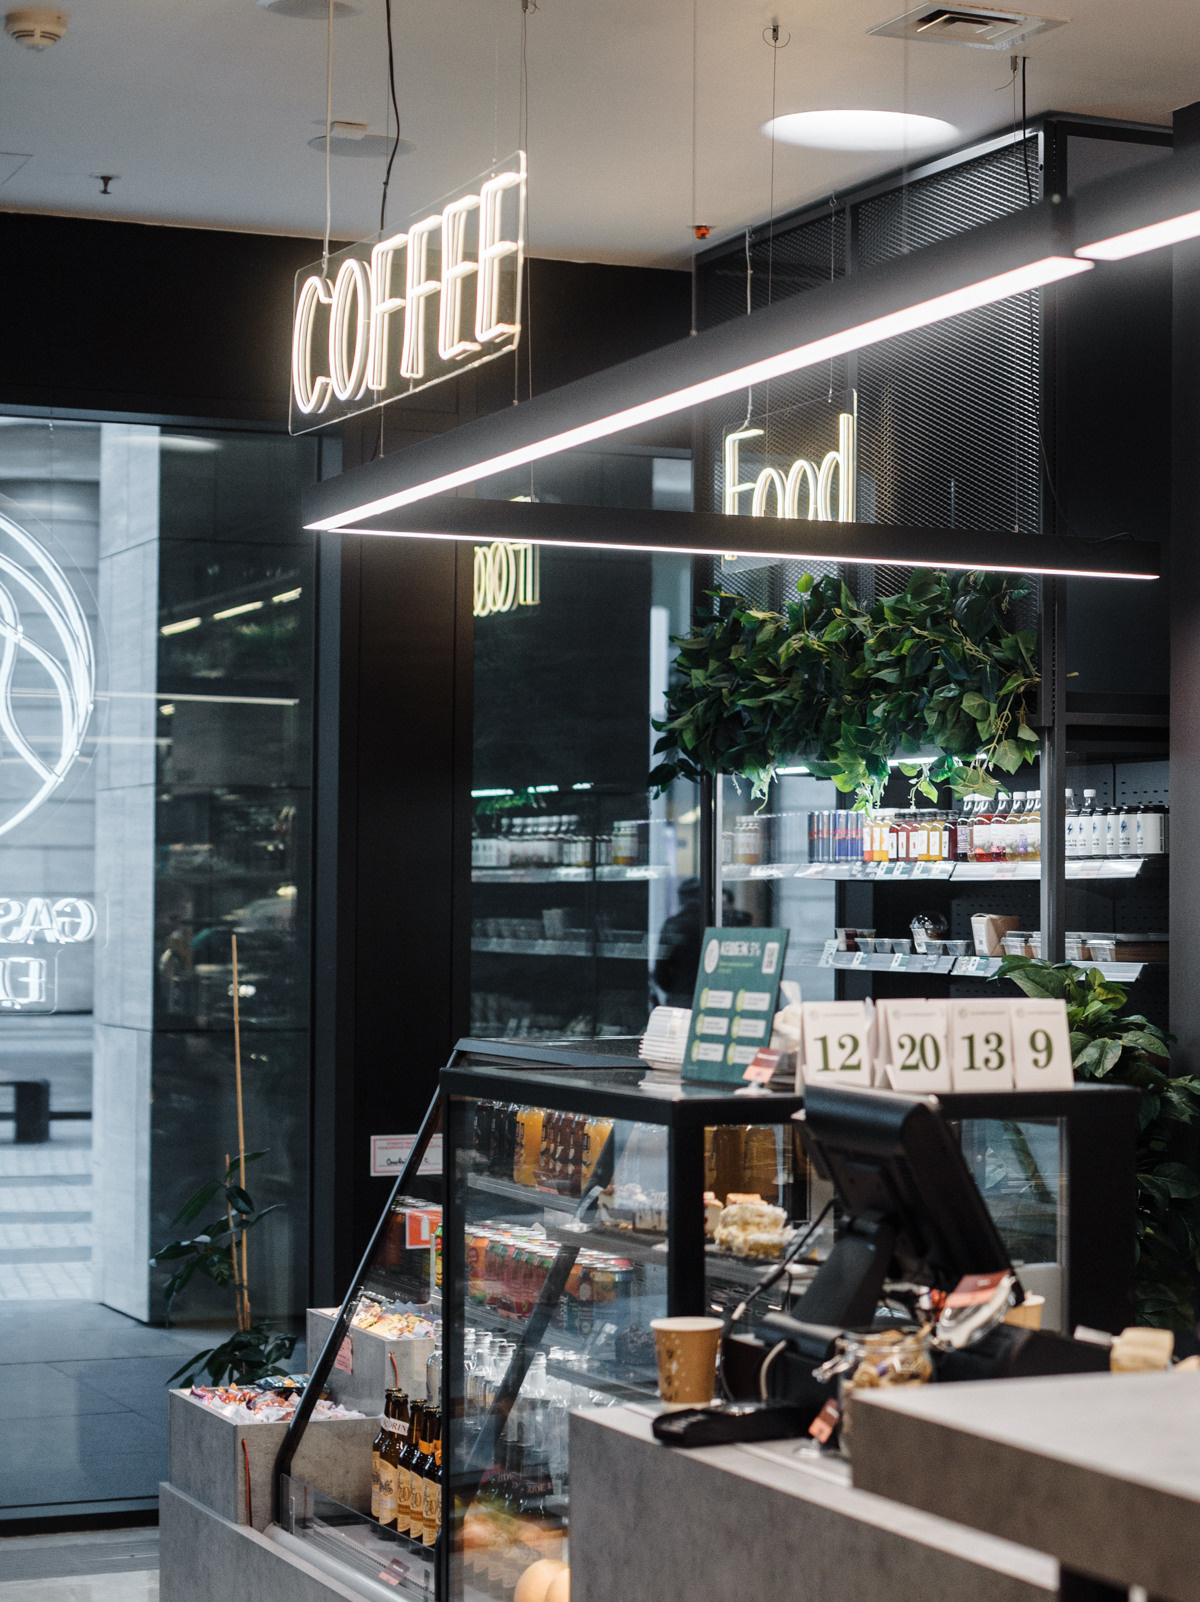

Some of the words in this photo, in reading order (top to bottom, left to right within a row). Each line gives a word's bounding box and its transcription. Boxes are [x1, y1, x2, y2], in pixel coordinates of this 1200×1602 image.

[292, 168, 524, 414] COFFEE
[725, 413, 855, 548] Food
[814, 1033, 862, 1073] 12
[898, 1033, 941, 1073] 20
[961, 1031, 1006, 1072] 13
[1028, 1029, 1052, 1069] 9
